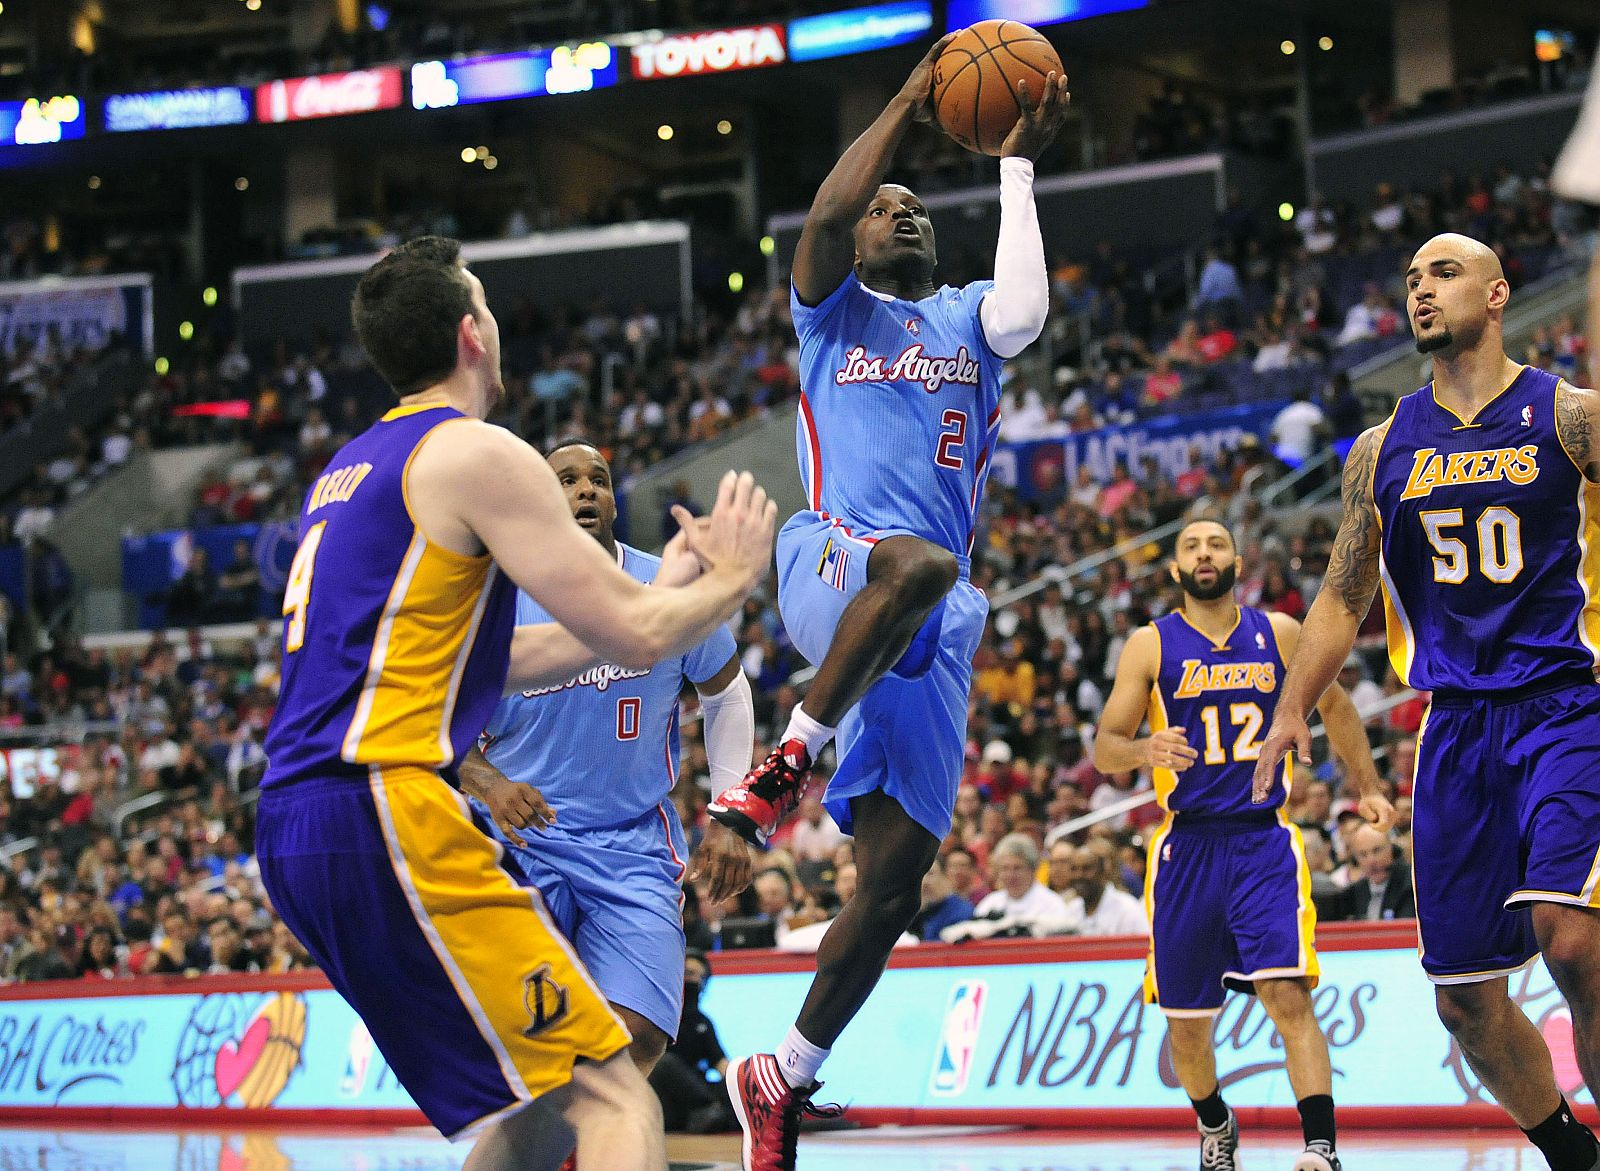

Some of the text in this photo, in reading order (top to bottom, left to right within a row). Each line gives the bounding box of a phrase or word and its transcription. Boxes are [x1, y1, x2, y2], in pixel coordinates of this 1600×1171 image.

[630, 27, 785, 77] TOYOTA
[836, 343, 980, 394] Los Angeles
[934, 408, 968, 471] 2
[1400, 445, 1541, 502] LAKERS
[1418, 506, 1524, 584] 50
[282, 519, 328, 654] 4
[1173, 659, 1277, 699] LAKERS
[615, 696, 642, 741] 0
[1200, 701, 1265, 765] 12
[36, 1015, 146, 1090] Cares
[986, 981, 1378, 1088] NBA aes
